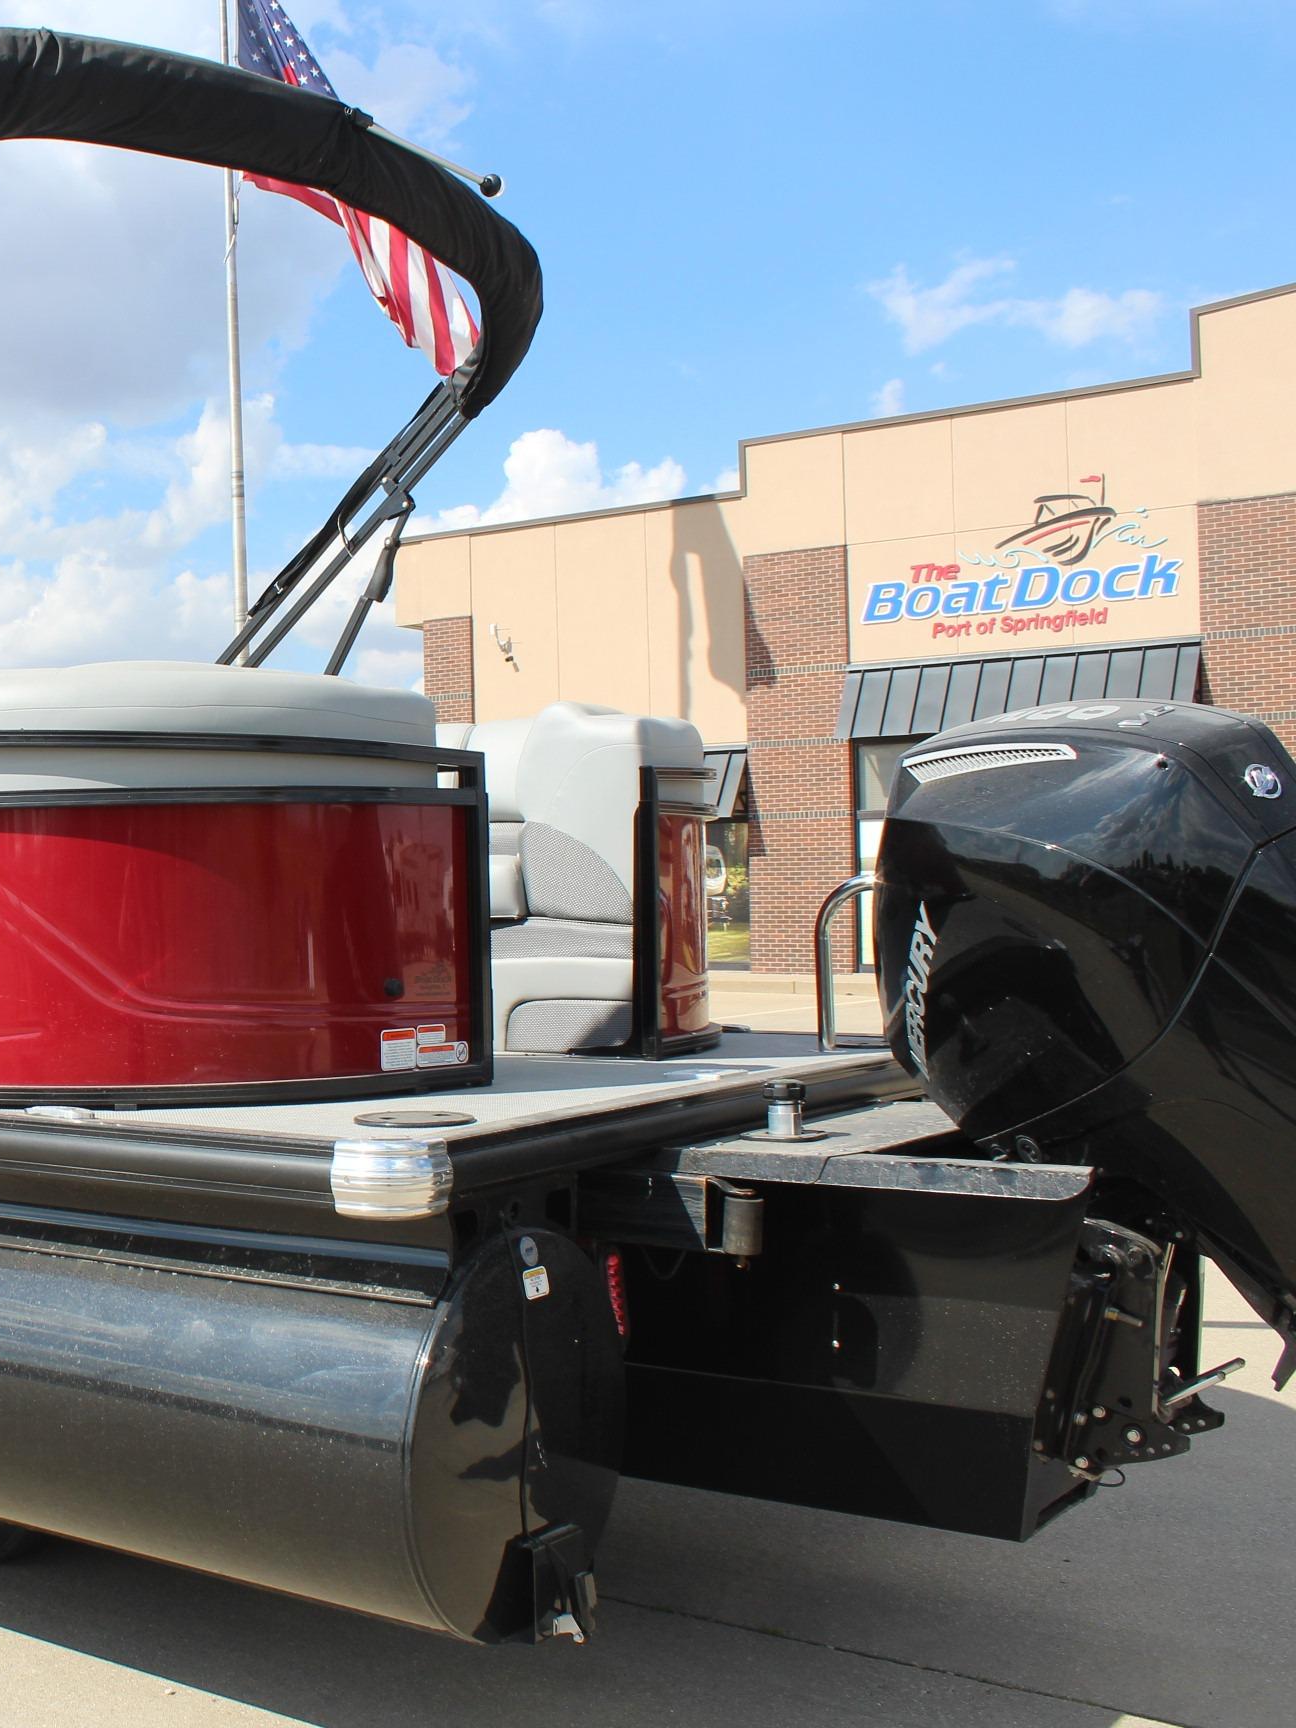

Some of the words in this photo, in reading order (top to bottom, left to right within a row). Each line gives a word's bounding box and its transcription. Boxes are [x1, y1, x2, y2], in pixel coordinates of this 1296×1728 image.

[910, 563, 960, 583] The
[932, 621, 971, 638] Port
[976, 618, 996, 635] of
[1001, 607, 1108, 636] Springfield
[905, 900, 938, 1081] MERCURY
